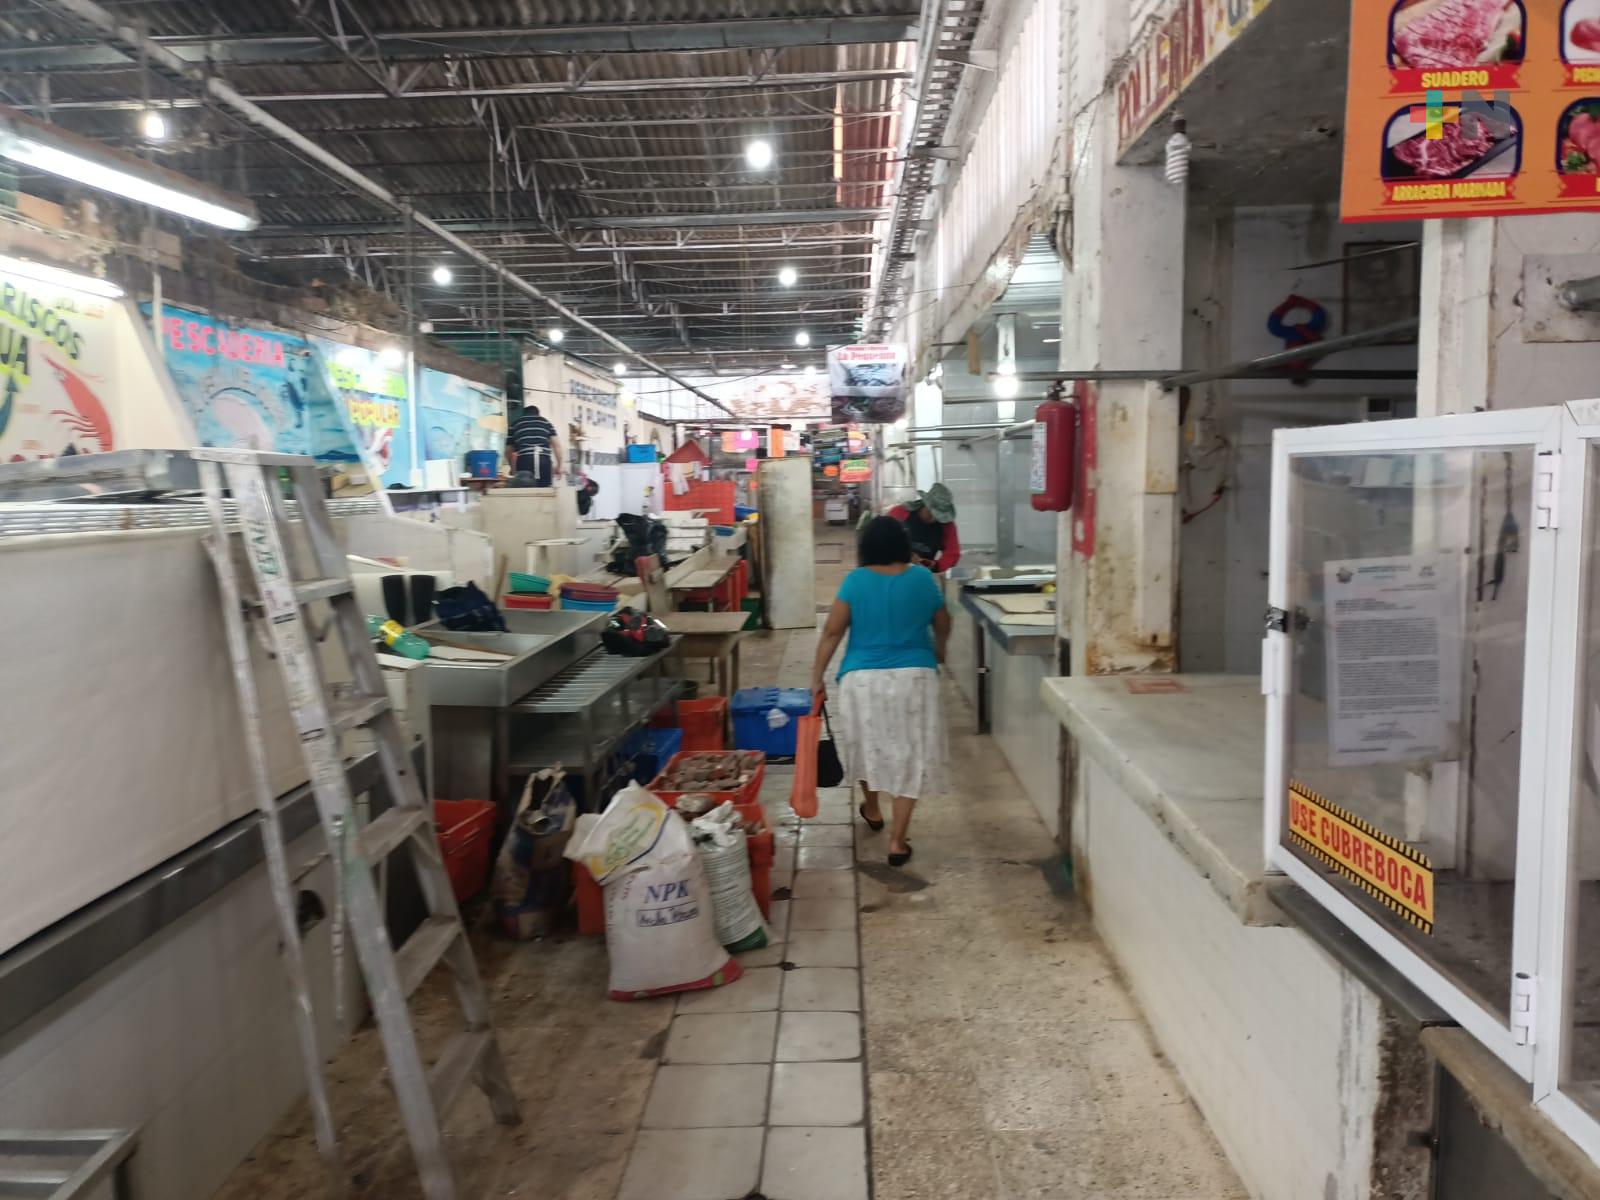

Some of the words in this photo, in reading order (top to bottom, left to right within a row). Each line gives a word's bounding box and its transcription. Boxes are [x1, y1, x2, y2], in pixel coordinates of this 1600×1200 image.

[1421, 70, 1489, 88] SUADERO
[1291, 798, 1317, 838] USE
[1321, 816, 1427, 911] CUBREBOCA
[643, 878, 690, 904] NPK
